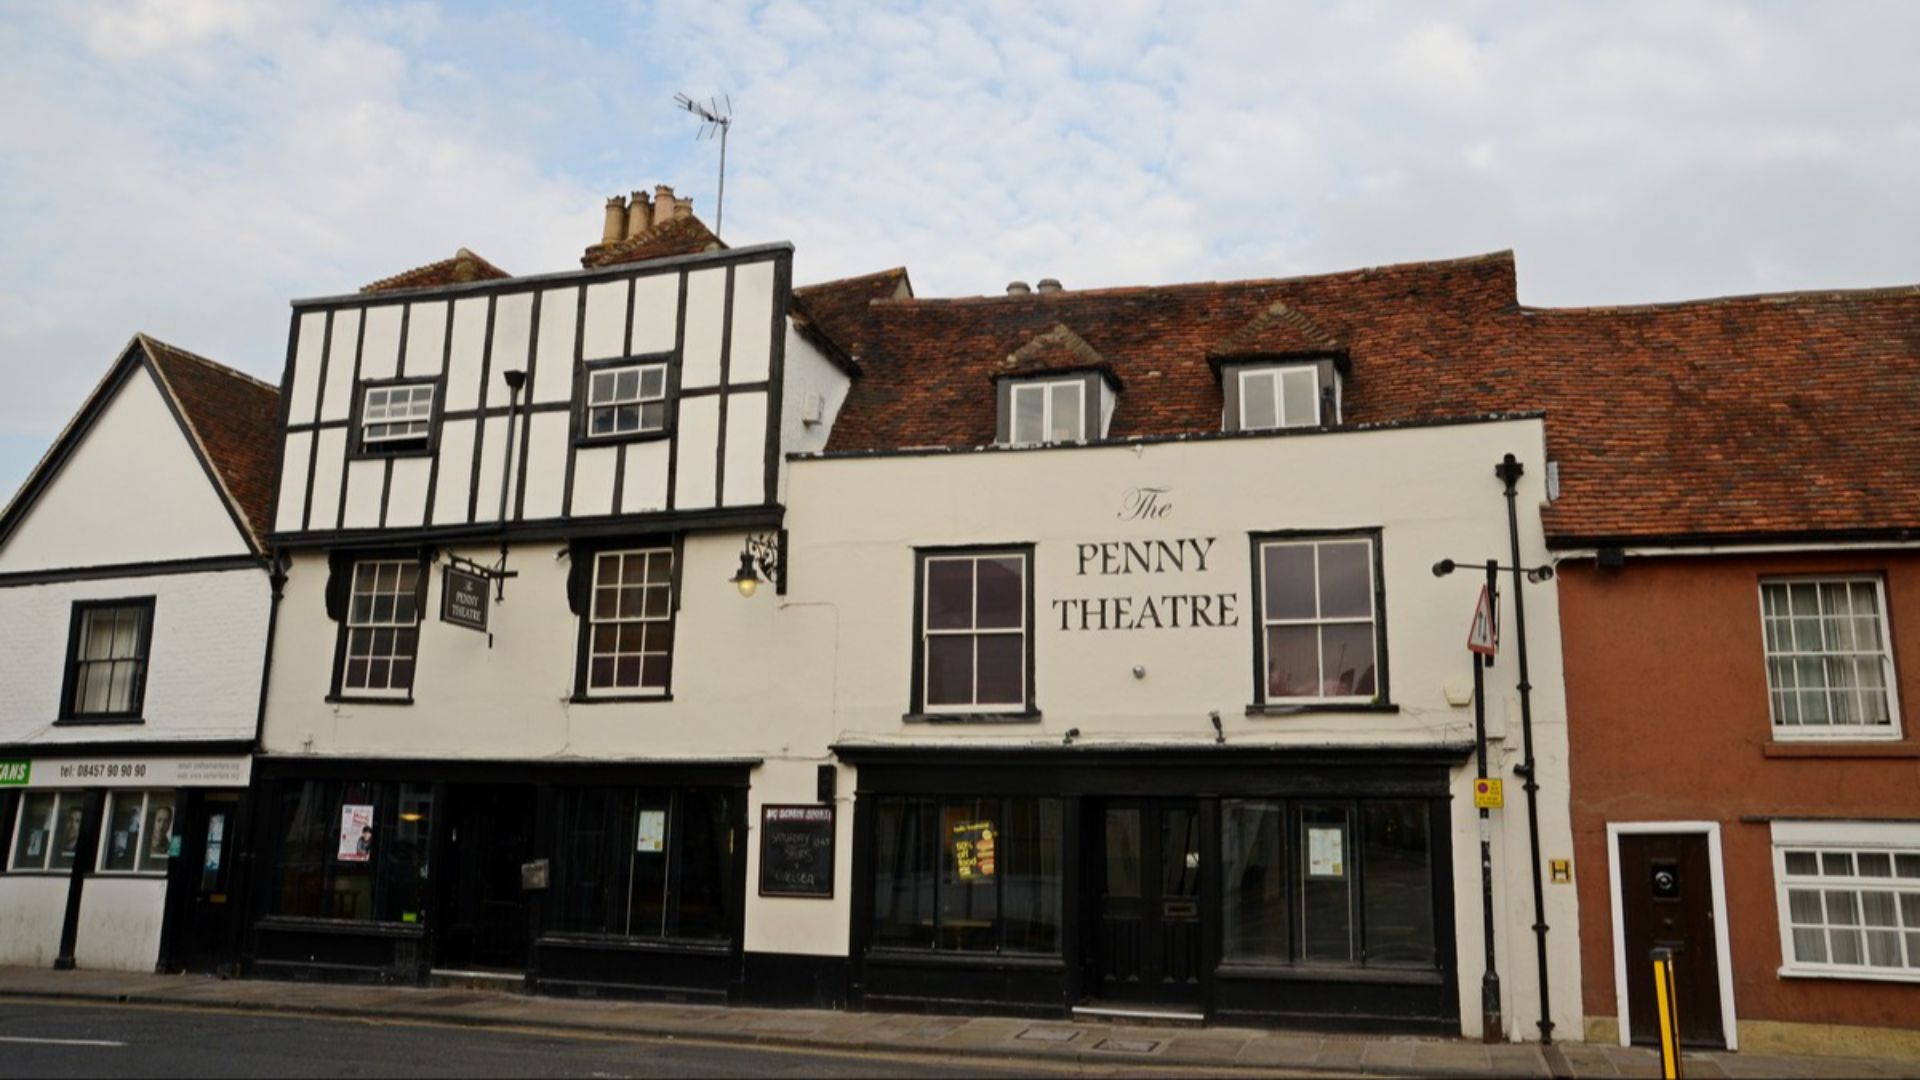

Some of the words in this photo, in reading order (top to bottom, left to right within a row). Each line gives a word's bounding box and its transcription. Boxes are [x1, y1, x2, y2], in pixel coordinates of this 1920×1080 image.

[1116, 486, 1172, 521] The
[1076, 537, 1216, 576] PENNY
[455, 591, 479, 607] PENNY
[452, 603, 481, 621] THEATRE
[1052, 593, 1239, 631] THEATRE
[0, 763, 27, 781] ANS
[60, 765, 74, 777] tel:
[78, 764, 105, 777] 08457
[107, 764, 119, 777] 90
[121, 764, 132, 777] 90
[134, 764, 146, 777] 90
